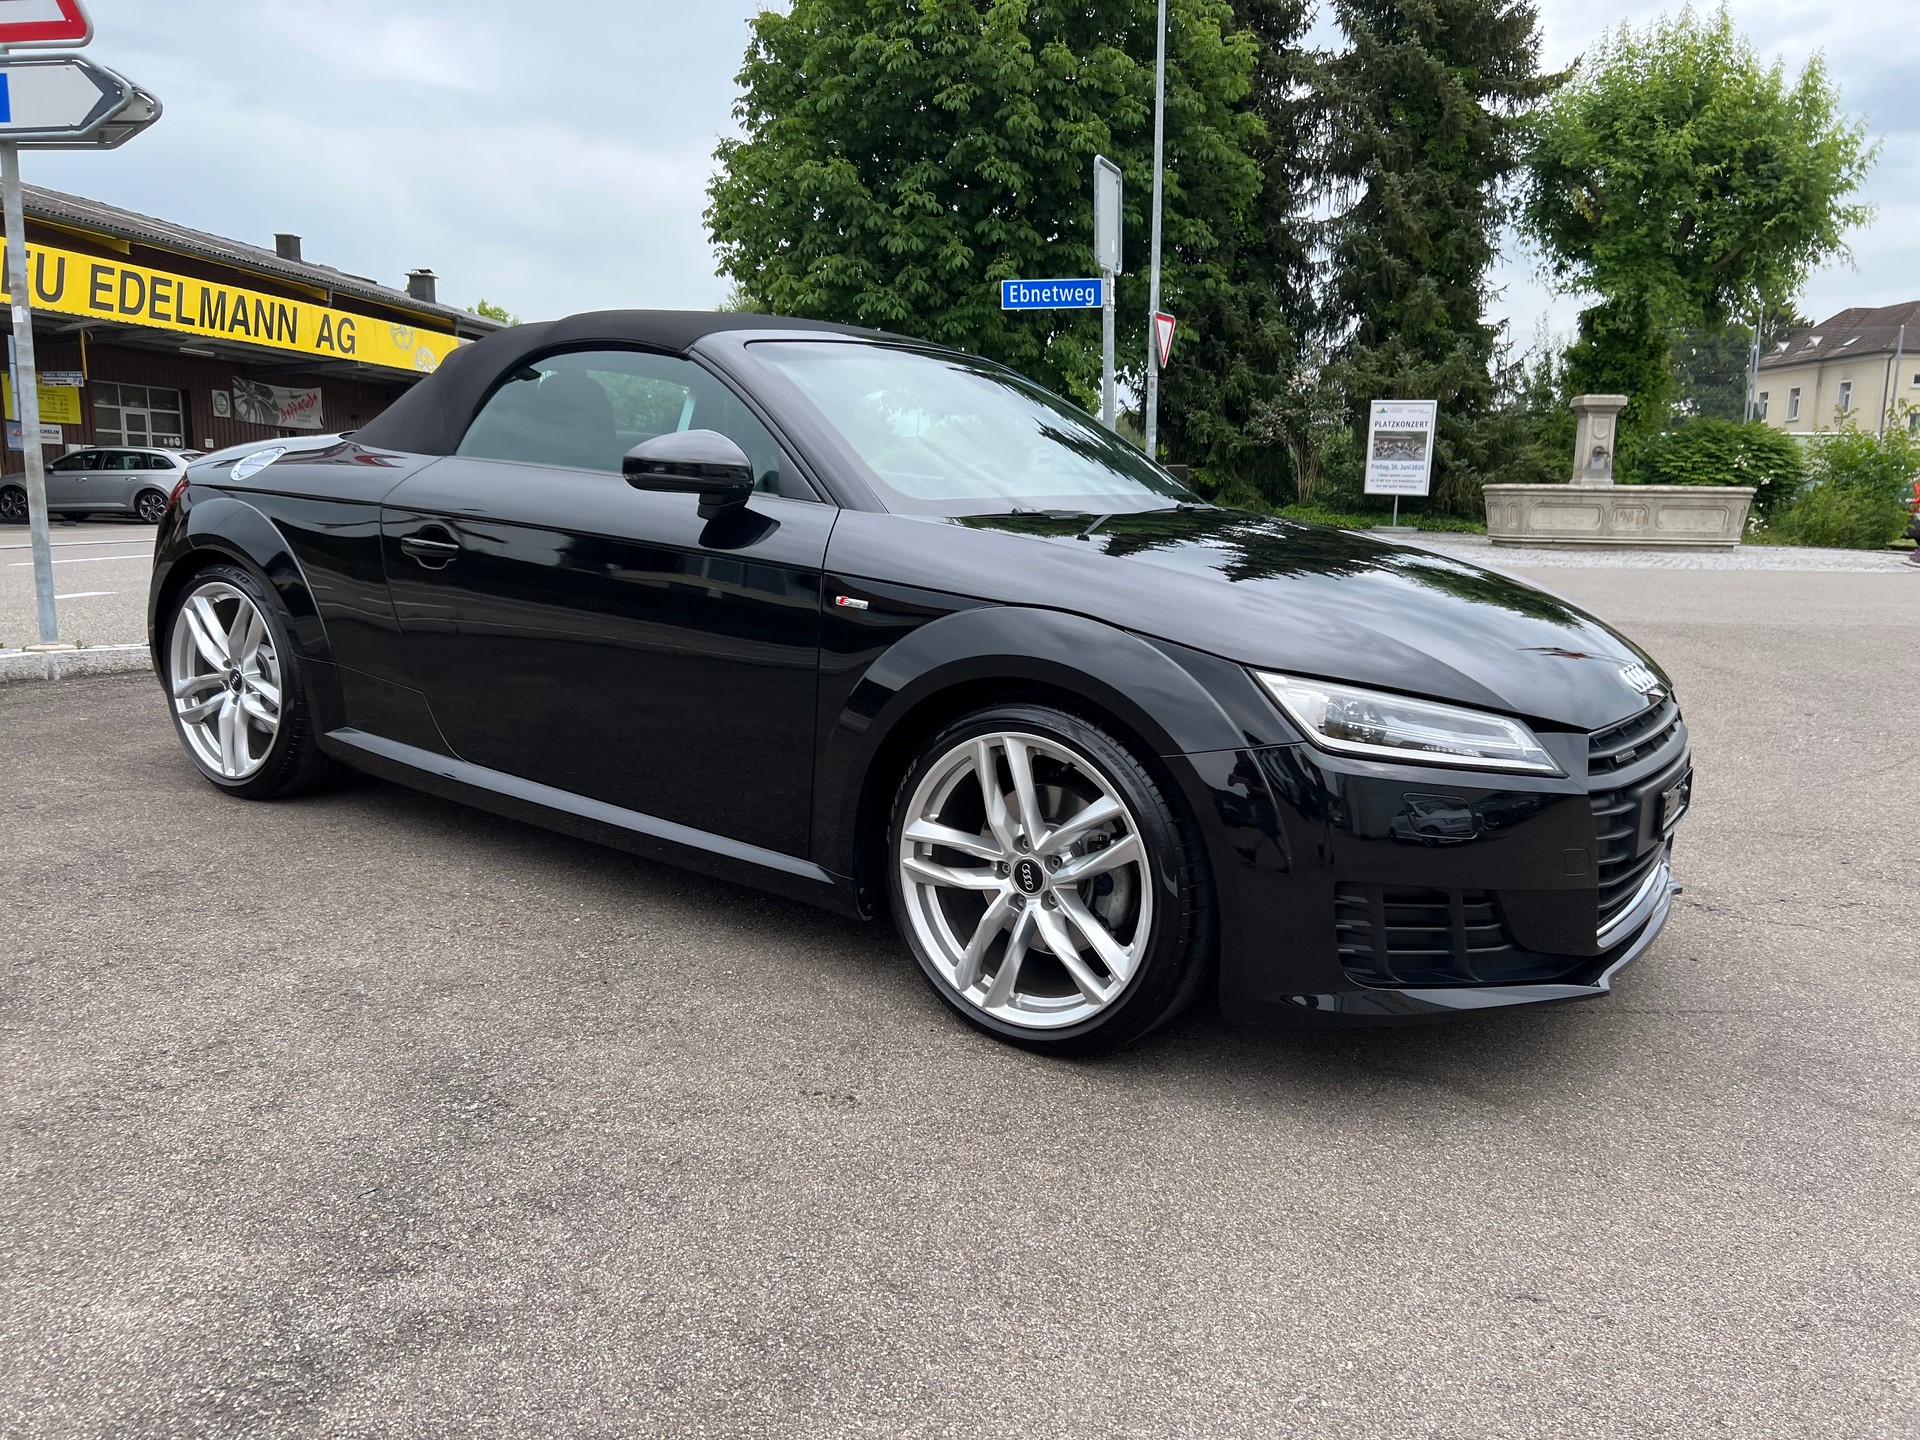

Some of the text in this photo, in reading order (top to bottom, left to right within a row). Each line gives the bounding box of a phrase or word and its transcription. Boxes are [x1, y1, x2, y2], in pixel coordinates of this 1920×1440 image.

[1010, 284, 1095, 306] Ebnetweg
[89, 264, 297, 344] EDELMANN
[315, 314, 356, 354] AG
[1374, 420, 1428, 428] PLATZKONZERT
